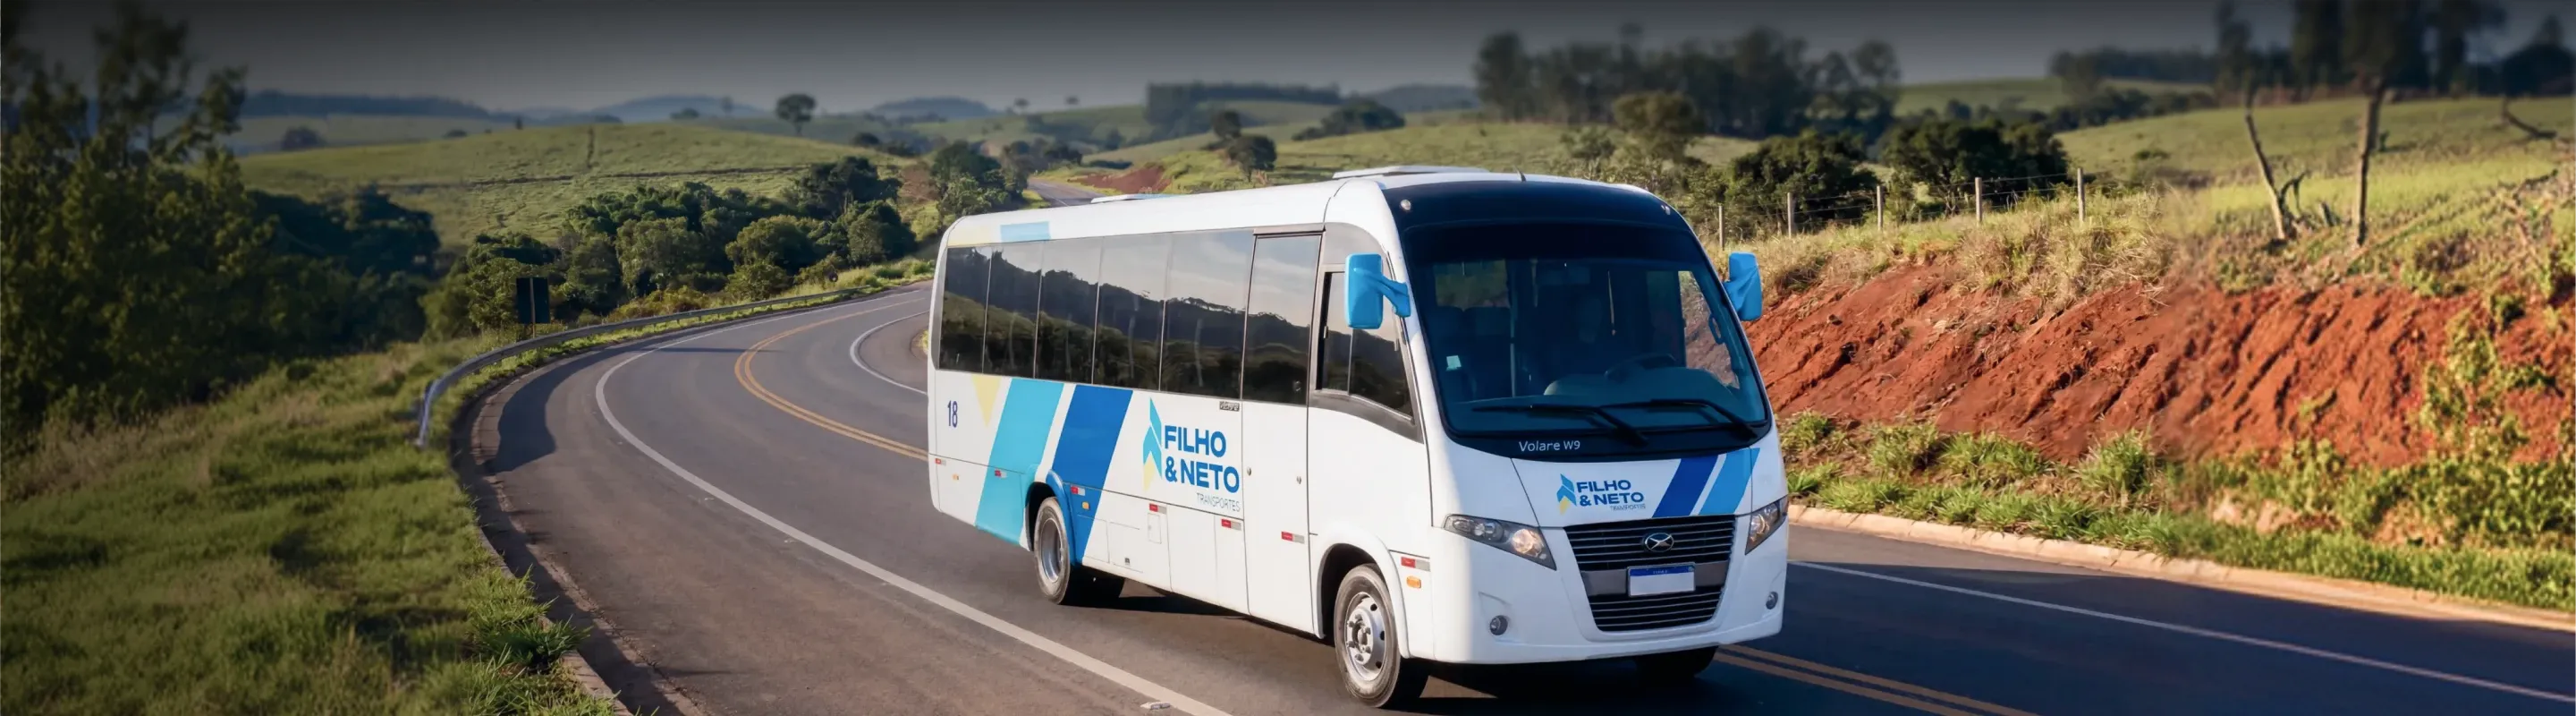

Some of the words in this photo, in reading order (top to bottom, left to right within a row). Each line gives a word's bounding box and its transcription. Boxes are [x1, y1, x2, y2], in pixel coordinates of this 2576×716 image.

[947, 400, 958, 428] 18
[1165, 425, 1226, 457] FILHO
[1519, 440, 1560, 452] Volare
[1563, 440, 1580, 450] W9
[1165, 456, 1178, 482] &
[1181, 458, 1240, 493] NETO
[1576, 480, 1631, 493] FILHO
[1197, 492, 1241, 512] TRANSPORTES
[1580, 495, 1591, 507] &
[1593, 492, 1644, 506] NETO
